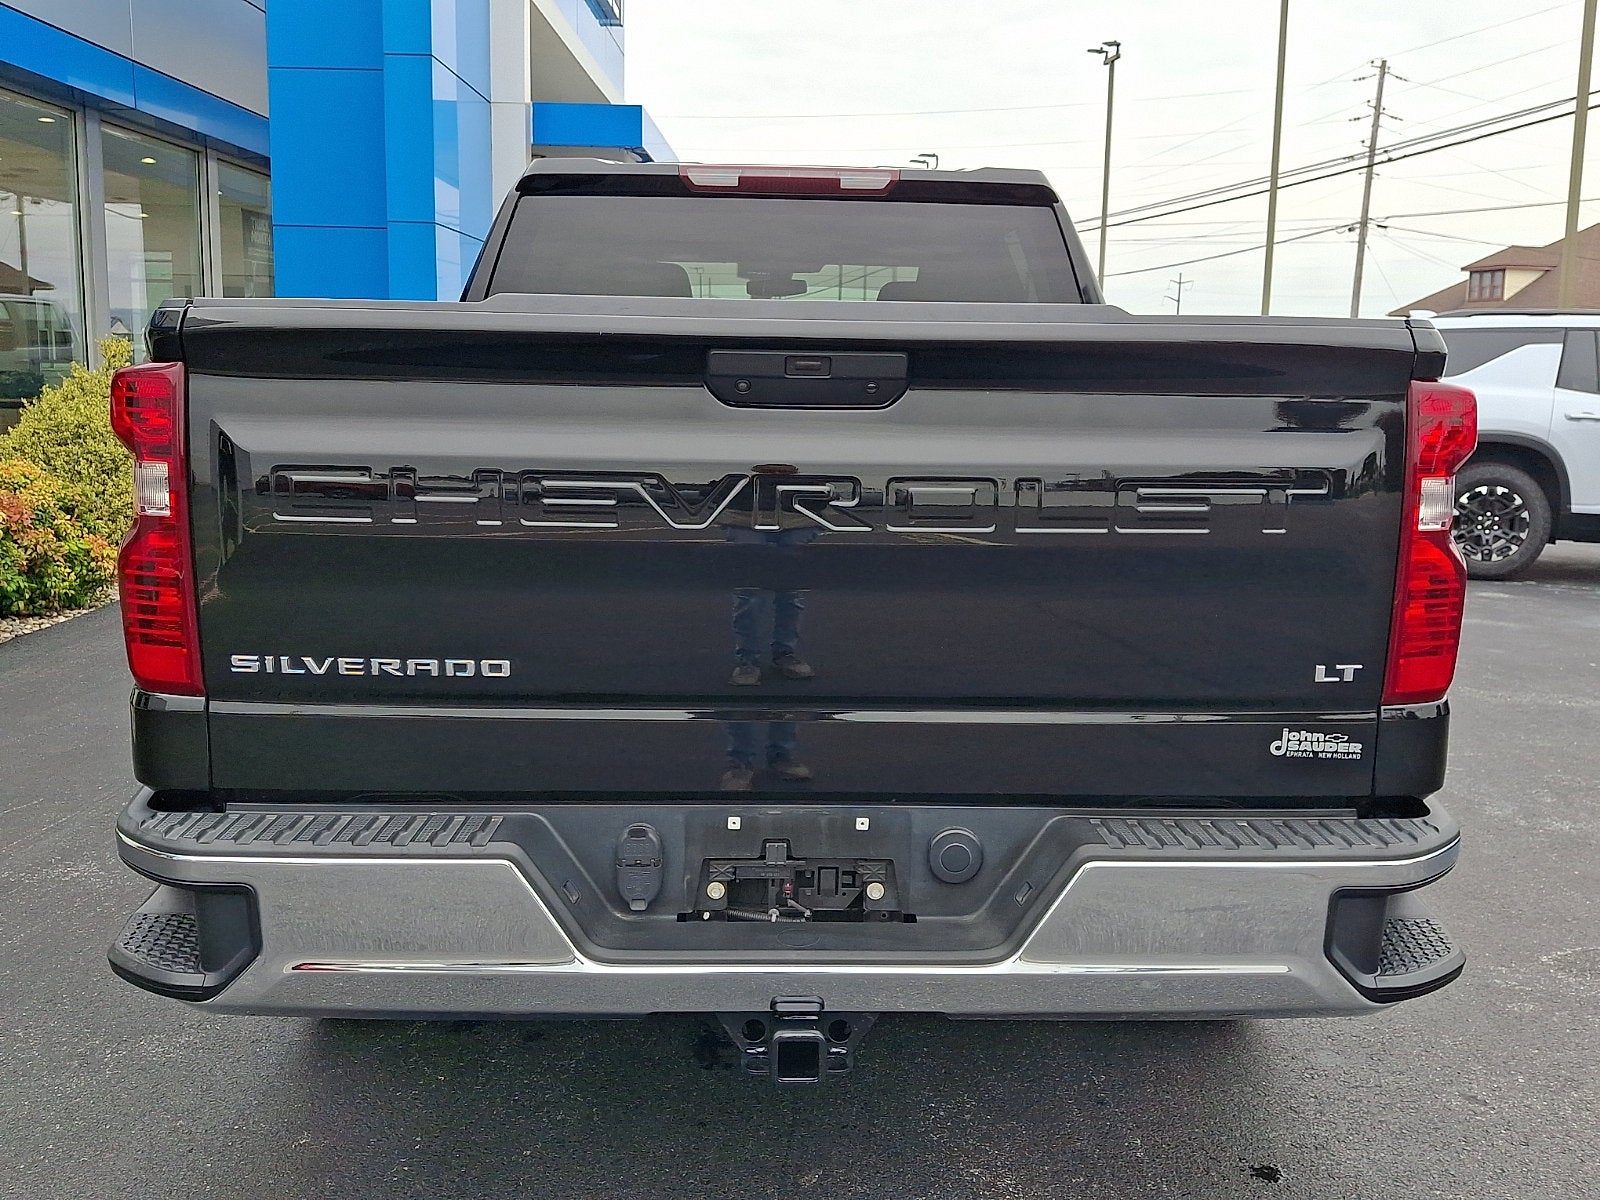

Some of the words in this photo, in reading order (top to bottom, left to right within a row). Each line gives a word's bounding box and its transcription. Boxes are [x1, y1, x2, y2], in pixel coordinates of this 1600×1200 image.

[270, 464, 1332, 534] CHEVROLET
[230, 654, 511, 677] SILVERADO
[1314, 664, 1363, 682] LT
[1287, 741, 1363, 753] SAUDER
